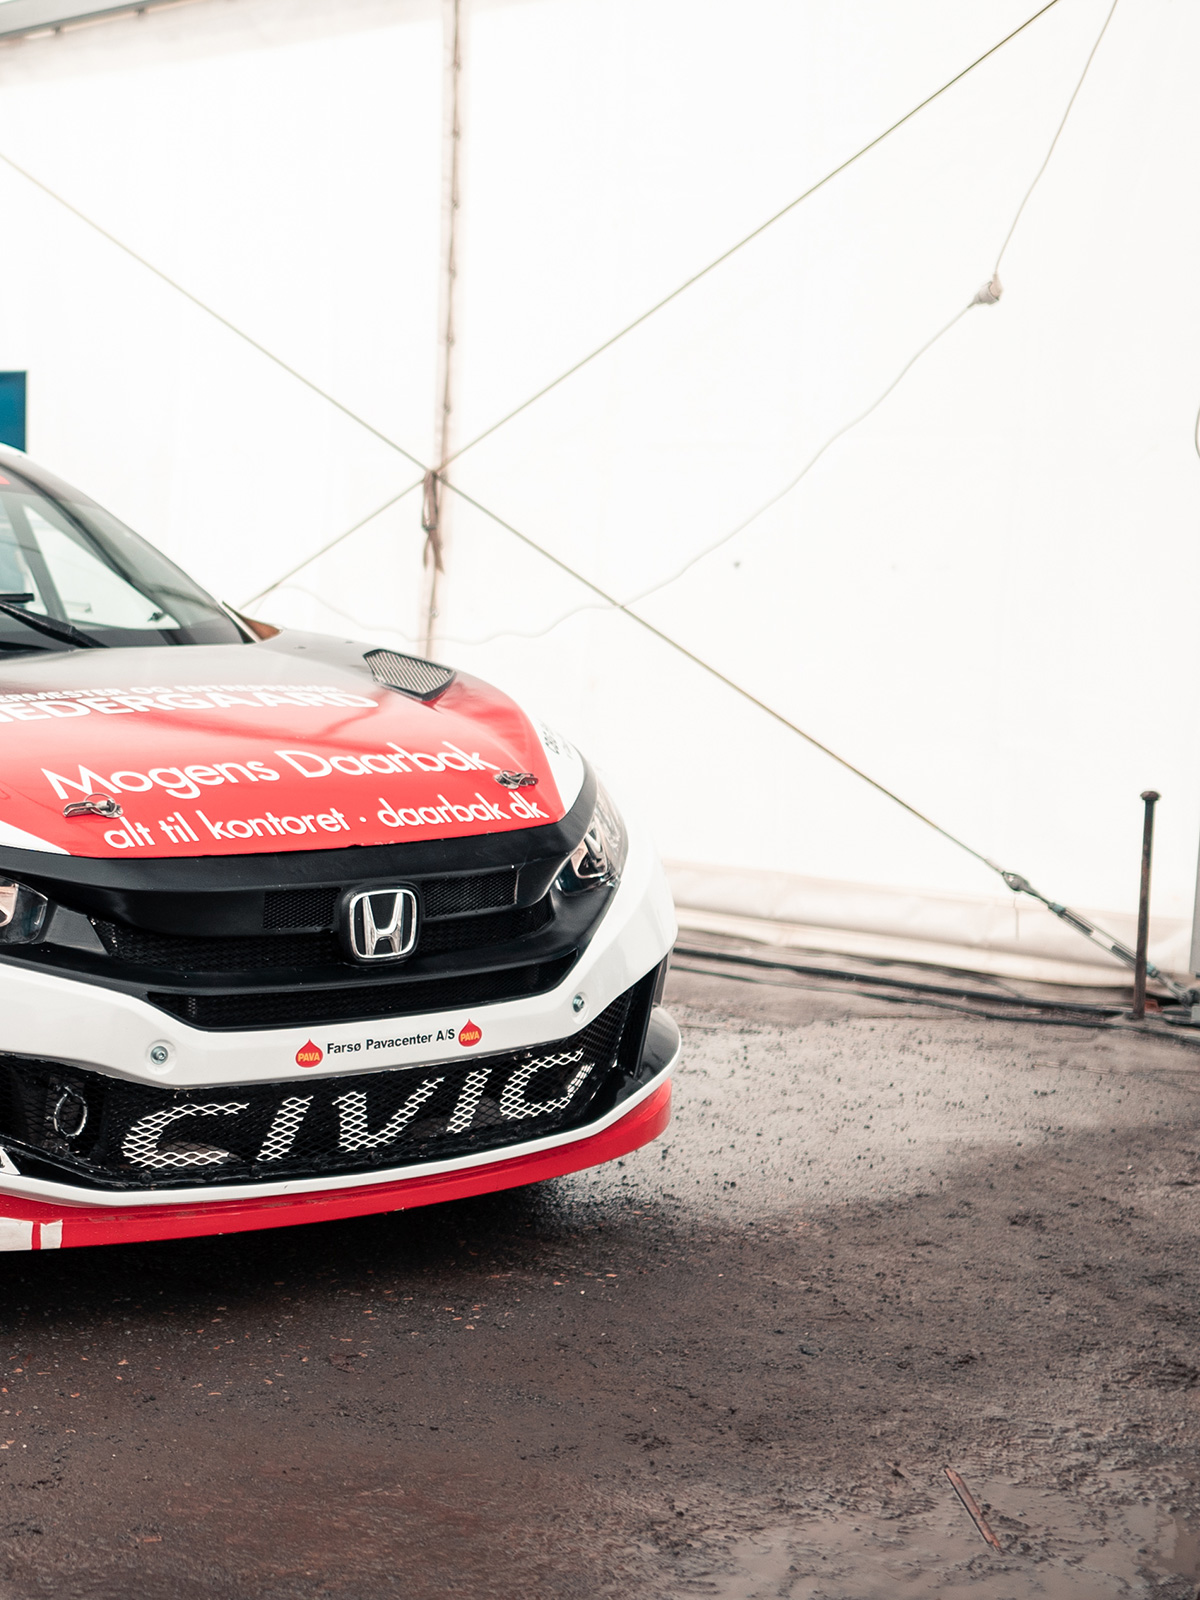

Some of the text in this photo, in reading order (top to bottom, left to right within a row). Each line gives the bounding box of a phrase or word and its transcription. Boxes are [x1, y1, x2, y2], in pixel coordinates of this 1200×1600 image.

[130, 686, 174, 695] OG
[40, 740, 502, 799] Mogens Daarbak
[103, 816, 156, 849] alt
[158, 812, 200, 844] til
[195, 808, 351, 841] kontoret
[297, 1028, 481, 1063] PAVA Farsø Pavacenter A/S PAVA
[121, 1047, 595, 1168] CIVIC
